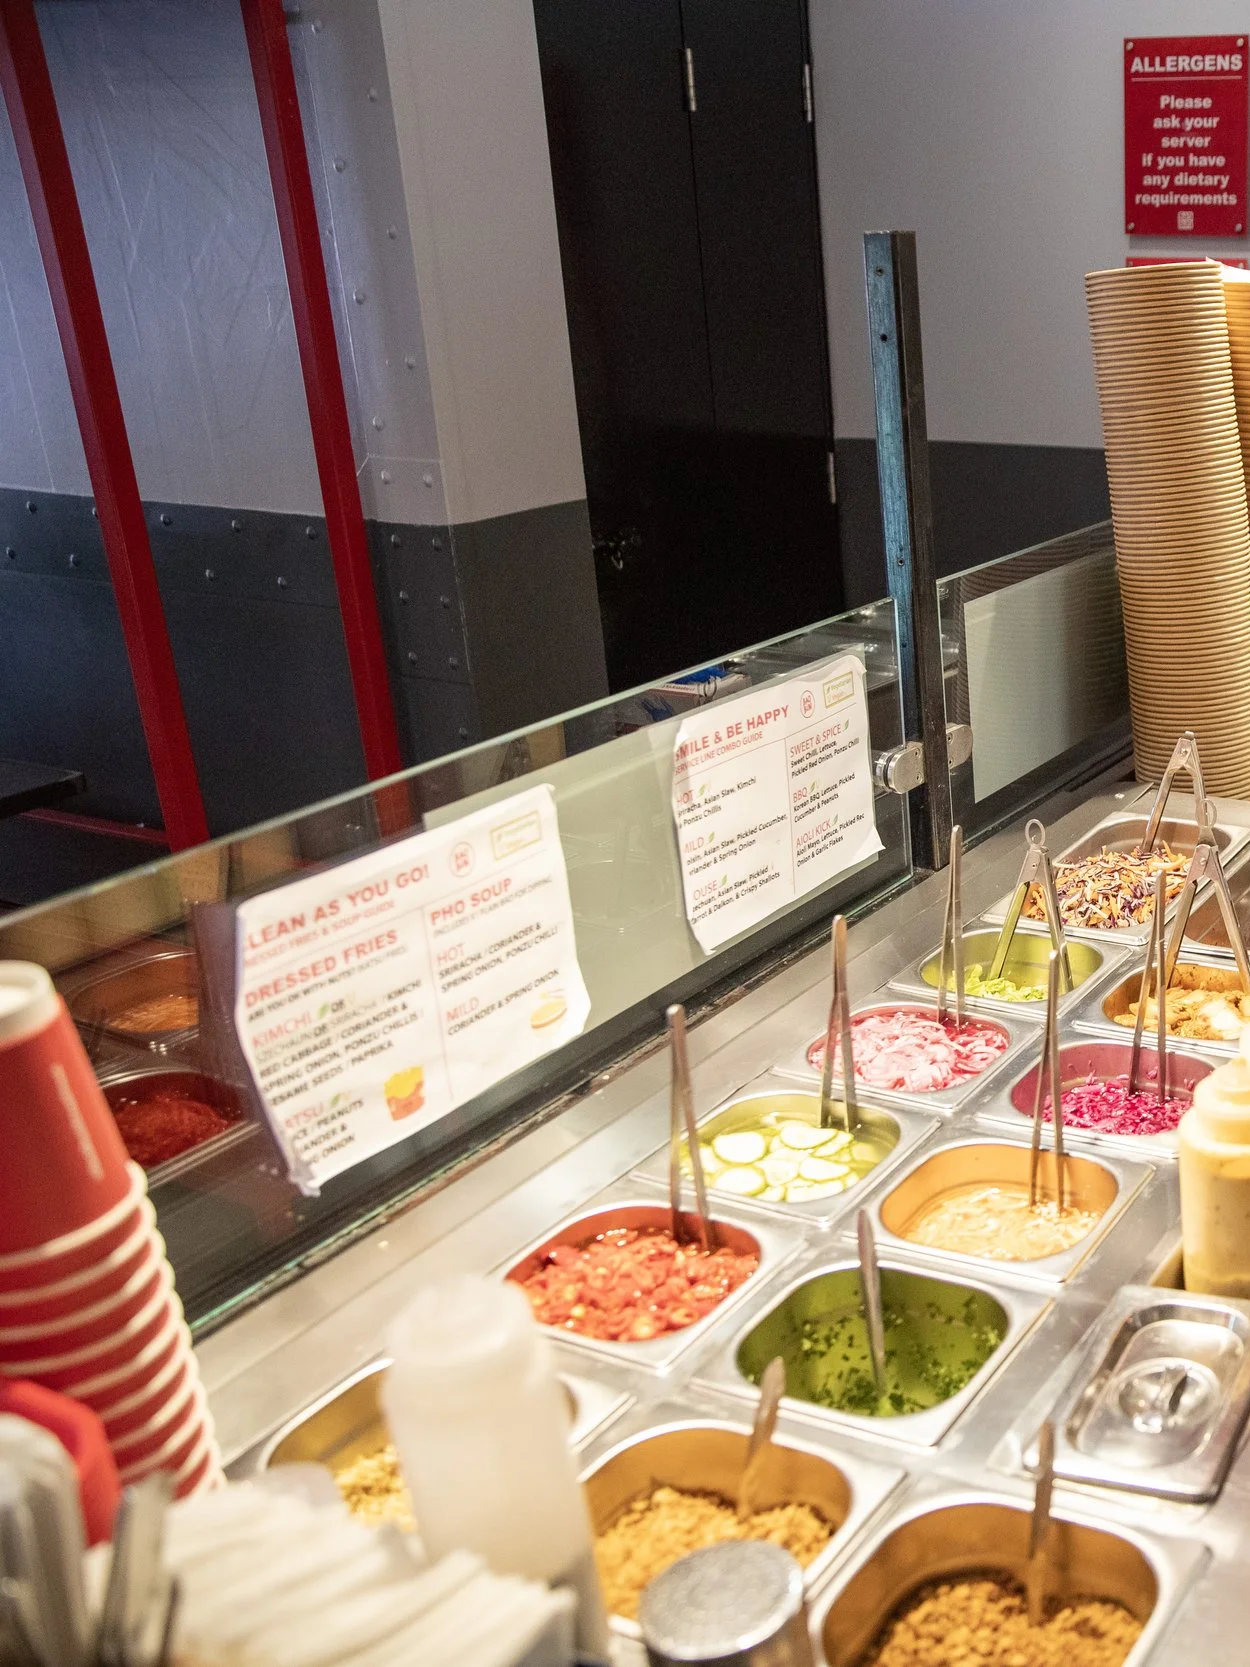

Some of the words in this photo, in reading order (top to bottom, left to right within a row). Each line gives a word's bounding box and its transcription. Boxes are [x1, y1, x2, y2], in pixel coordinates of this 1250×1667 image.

[1131, 54, 1243, 73] ALLERGENS
[1160, 95, 1212, 109] Please
[1153, 114, 1180, 128] ask
[1185, 116, 1219, 131] your
[1161, 136, 1211, 148] server
[1157, 155, 1185, 170] you
[1189, 153, 1226, 167] have
[1143, 175, 1170, 189] any
[1174, 172, 1230, 189] dietary
[1135, 191, 1238, 208] requirements
[714, 731, 723, 745] &
[726, 722, 744, 739] BE
[747, 705, 789, 731] HAPPY
[743, 731, 763, 746] GUIDE
[790, 737, 814, 758] SWEET
[816, 734, 821, 745] &
[822, 724, 842, 742] SPICE
[791, 756, 805, 768] Sweet
[792, 765, 808, 780] Pickled
[809, 760, 818, 770] Red
[834, 746, 847, 757] Ponzu
[704, 793, 720, 804] Asian
[737, 776, 757, 791] Kimchi
[793, 787, 808, 803] BBQ
[794, 800, 809, 813] Korean
[839, 772, 855, 786] Pickled
[683, 815, 702, 826] Ponzu
[795, 806, 816, 823] Cucumber
[821, 793, 839, 808] Peanuts
[816, 819, 831, 837] KICK
[840, 817, 856, 830] Pickled
[704, 845, 720, 857] Asian
[737, 827, 758, 841] Pickled
[719, 848, 737, 862] Spring
[739, 840, 757, 852] Onion
[797, 856, 811, 868] Onion
[816, 844, 829, 856] Garlic
[829, 835, 844, 847] Flakes
[709, 907, 713, 915] &
[741, 884, 758, 897] Crispy
[759, 872, 781, 887] Shallots
[718, 886, 733, 898] Asian
[749, 865, 769, 881] Pickled
[248, 913, 306, 949] LEAN
[314, 900, 340, 923] AS
[348, 880, 389, 906] YOU
[396, 864, 430, 889] GO!
[430, 899, 465, 926] PHO
[471, 877, 512, 908] SOUP
[437, 942, 465, 965] HOT
[438, 953, 483, 980] SRIRACHA
[489, 925, 535, 954] CORIANDER
[535, 922, 542, 931] &
[245, 956, 337, 1008] DRESSED
[343, 929, 398, 965] FRIES
[441, 972, 473, 994] SPRING
[506, 942, 533, 959] PONZU
[314, 1024, 328, 1037] OR
[388, 979, 421, 1001] KIMCHI
[446, 997, 480, 1022] MILD
[448, 1003, 496, 1036] CORIANDER
[497, 1000, 503, 1009] &
[504, 983, 533, 1005] SPRING
[535, 968, 560, 989] ONION
[252, 1012, 312, 1048] KIMCHI
[330, 1000, 345, 1013] OR
[283, 1038, 332, 1068] CABBAGE
[341, 1004, 399, 1039] CORIANDER
[401, 1003, 408, 1011] &
[345, 1031, 380, 1051] PONZU
[382, 1013, 418, 1035] CHILLIS
[272, 1082, 309, 1106] ESAME
[312, 1064, 344, 1087] SEEDS
[351, 1040, 394, 1067] PAPRIKA
[316, 1099, 364, 1127] PEANUTS
[341, 1123, 348, 1132] &
[322, 1133, 356, 1157] ONION
